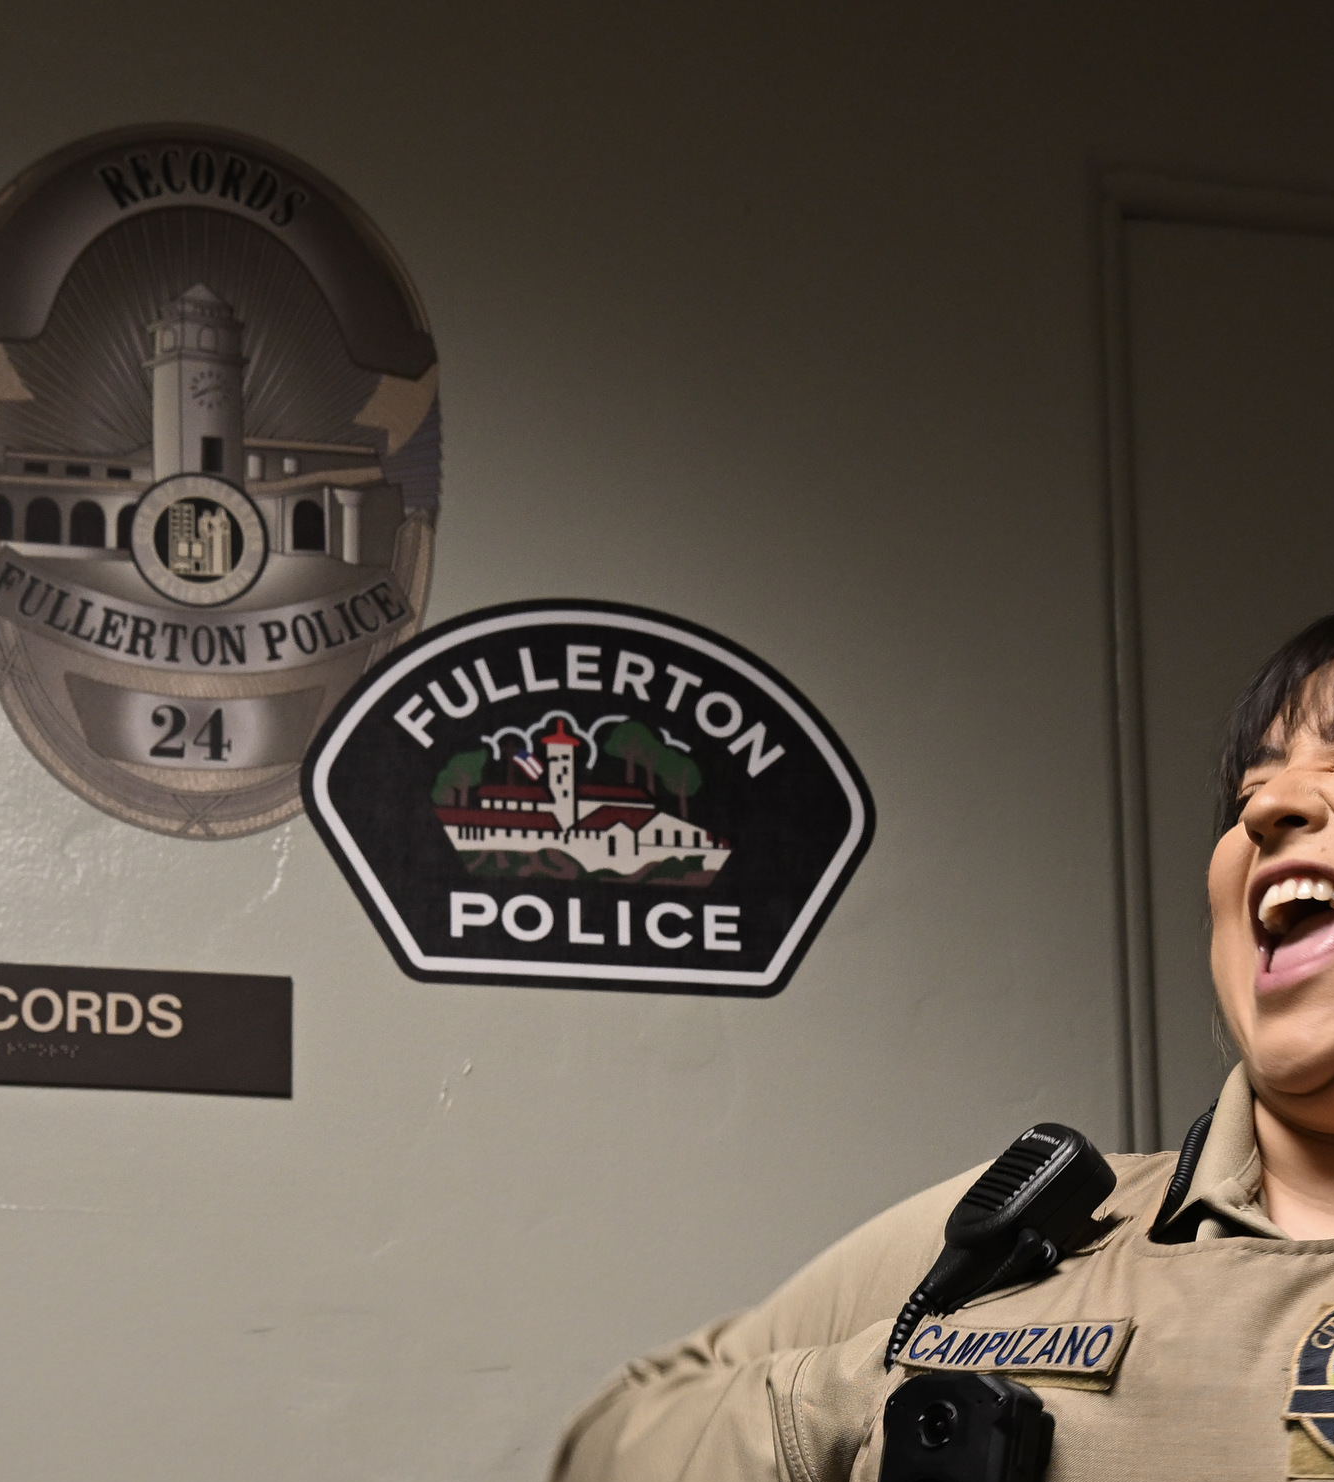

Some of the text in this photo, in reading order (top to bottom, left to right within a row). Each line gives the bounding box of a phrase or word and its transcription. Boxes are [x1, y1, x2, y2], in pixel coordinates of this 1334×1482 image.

[97, 149, 308, 227] RECORDS
[259, 582, 406, 661] POLICE
[149, 704, 233, 763] 24
[393, 644, 786, 779] FULLERTON
[450, 891, 741, 951] POLICE
[908, 1324, 1114, 1368] CAMPUZANO
